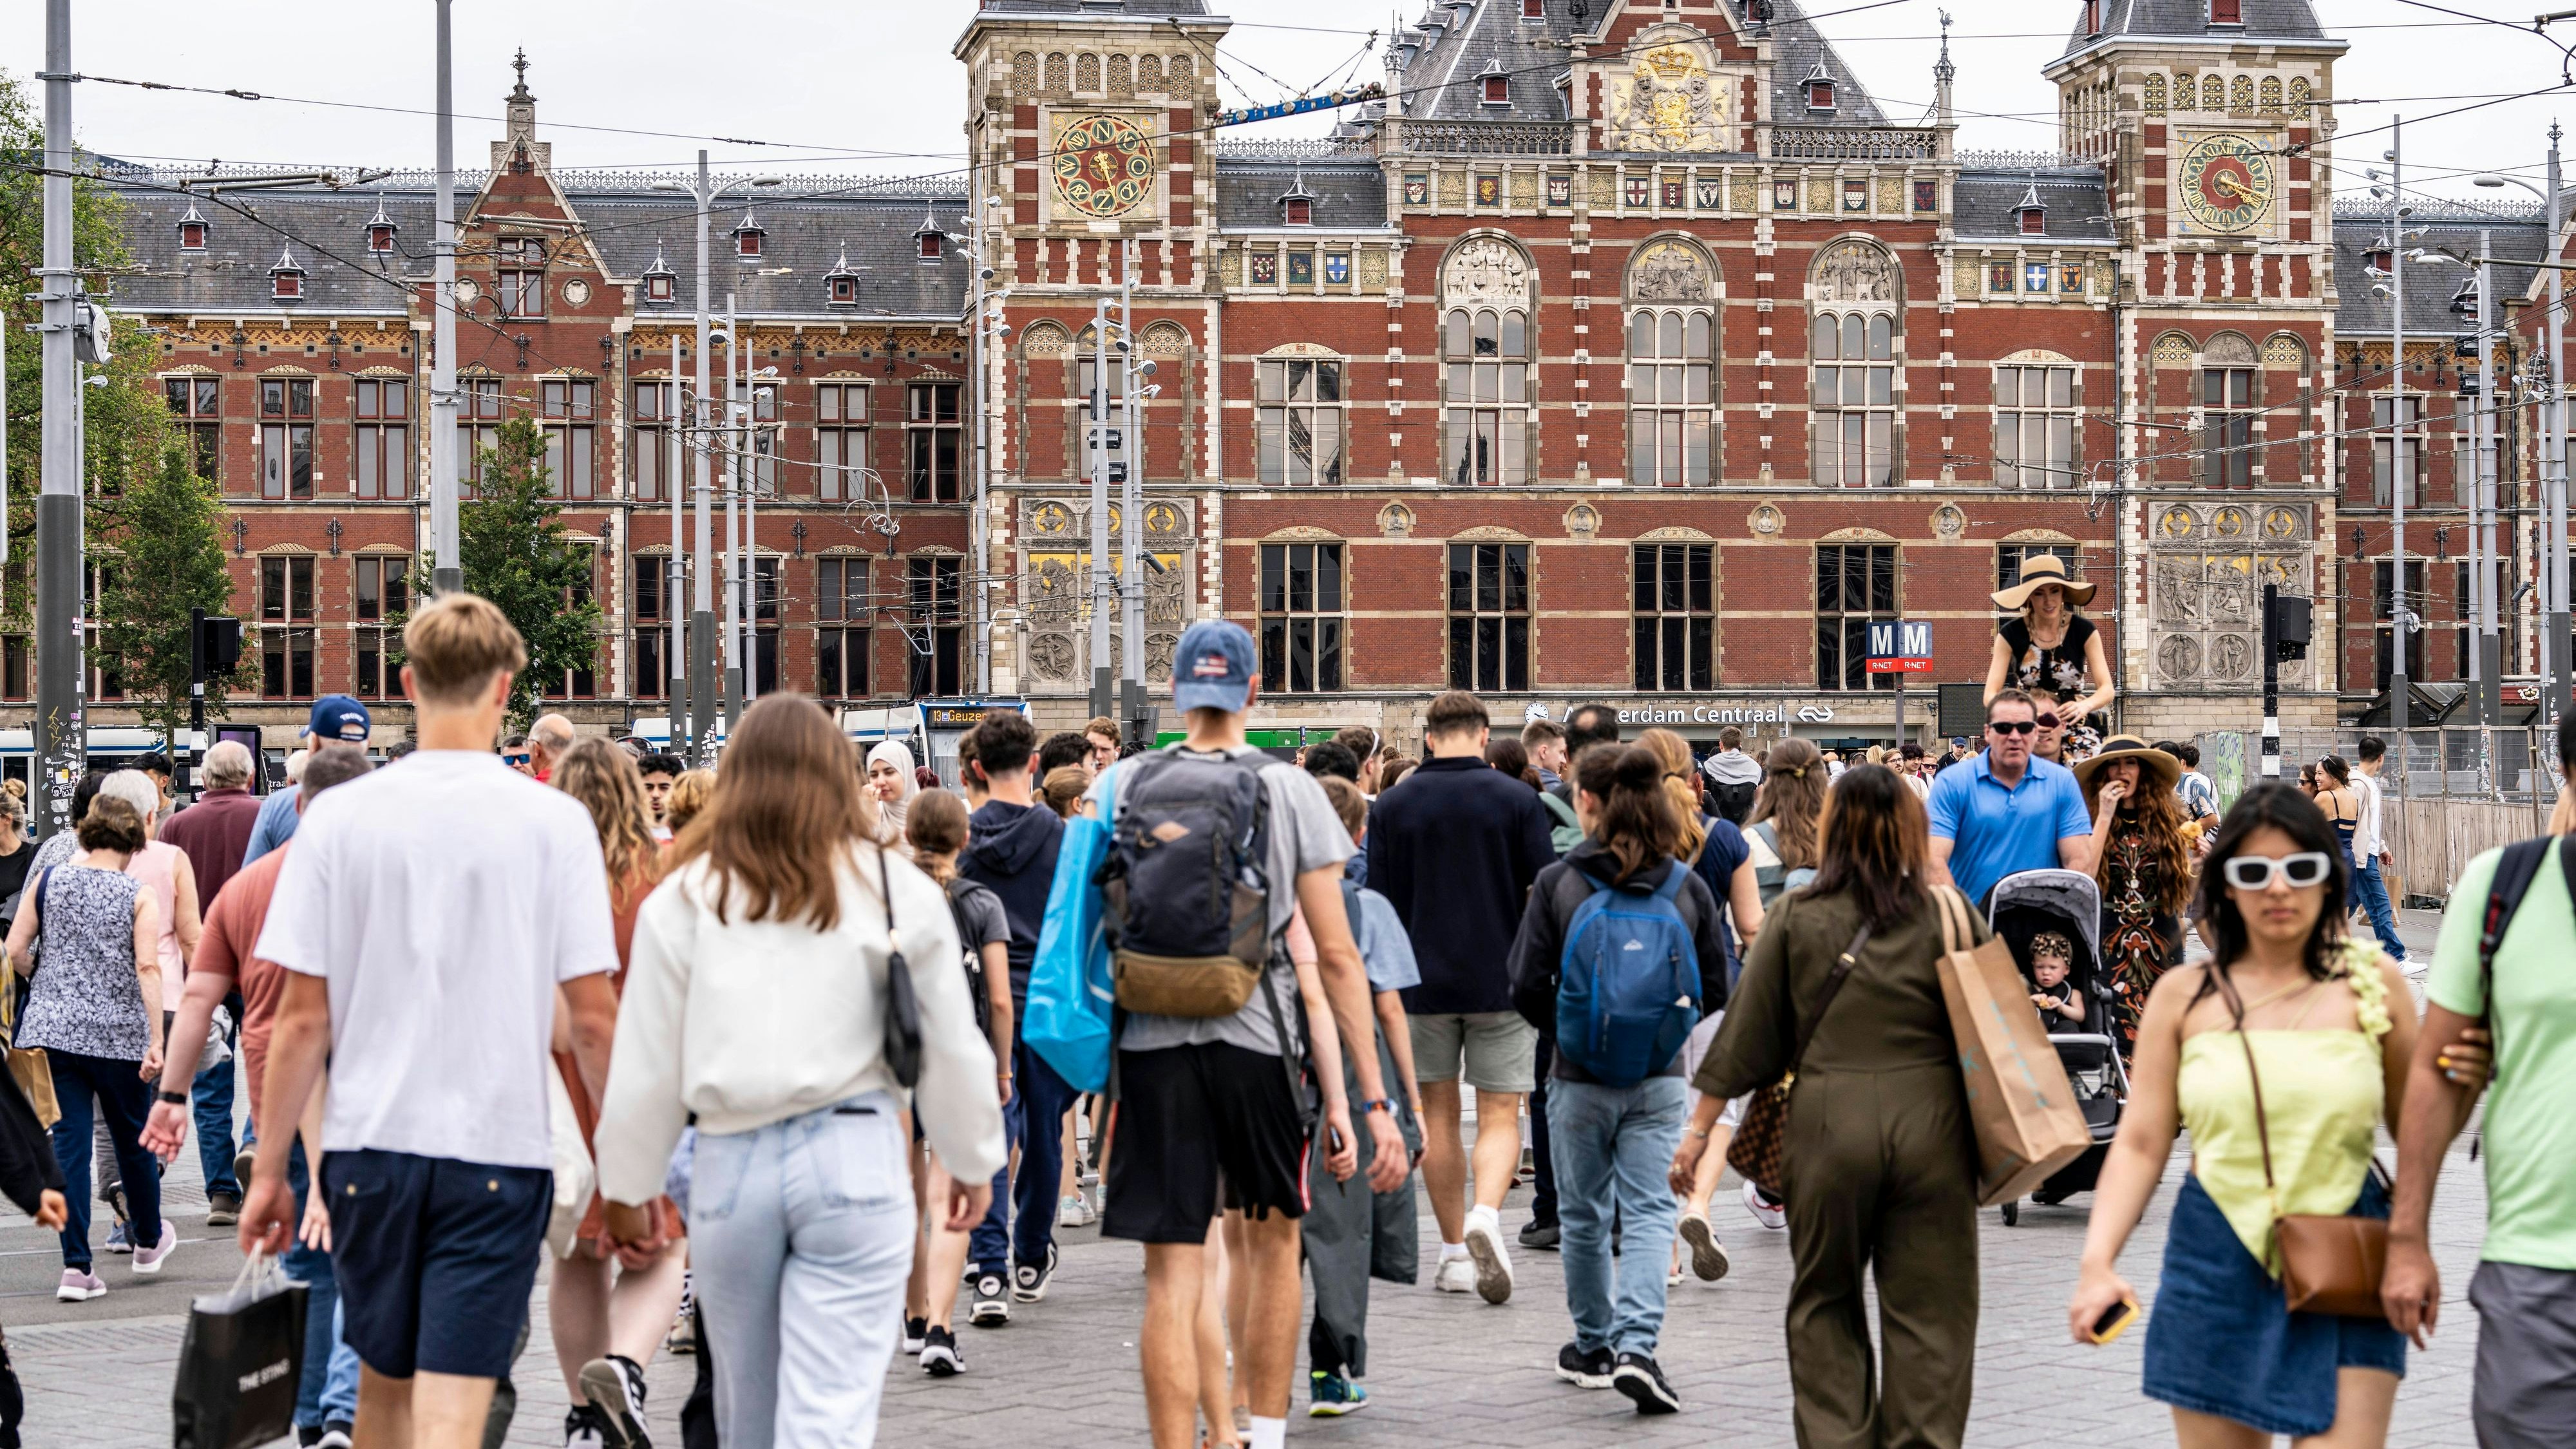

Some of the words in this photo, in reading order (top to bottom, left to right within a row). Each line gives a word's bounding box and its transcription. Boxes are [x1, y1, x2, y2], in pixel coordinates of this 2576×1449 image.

[1095, 123, 1112, 139] N
[1131, 159, 1146, 175] O
[1872, 625, 1892, 655] M
[1904, 625, 1926, 654] M
[934, 710, 942, 721] 13
[1693, 705, 1783, 723] Centraal
